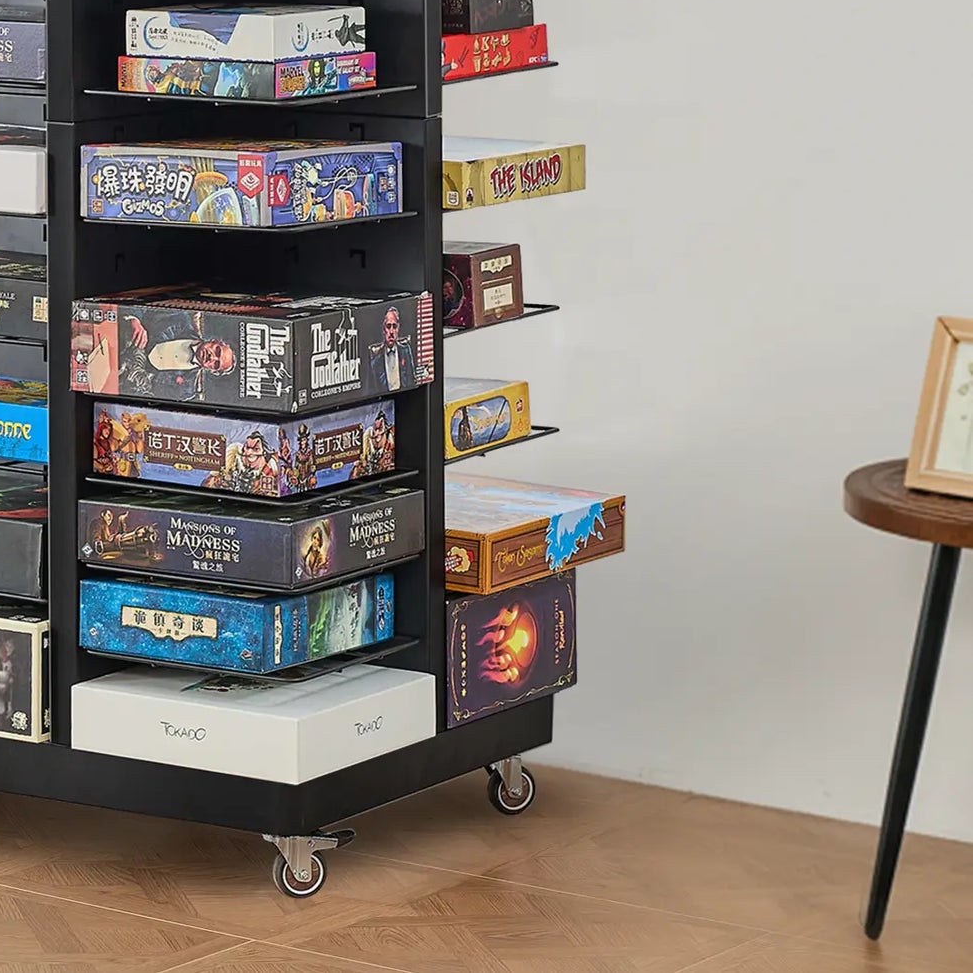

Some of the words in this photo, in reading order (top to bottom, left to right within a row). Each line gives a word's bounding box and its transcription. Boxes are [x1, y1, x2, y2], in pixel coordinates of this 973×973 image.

[280, 65, 304, 77] MARVEL
[96, 164, 194, 201] 爆珠發明
[489, 164, 517, 198] THE
[518, 153, 562, 193] ISLAND
[270, 326, 291, 356] The
[311, 323, 331, 354] The
[245, 322, 270, 399] Godfather
[310, 349, 361, 389] Godfather
[342, 381, 362, 392] EMPIRE
[148, 432, 222, 457] 诺丁汉警长
[314, 429, 361, 455] 诺丁汉警长
[149, 450, 174, 459] SHERIFF
[179, 454, 220, 465] NOTTINGHAM
[170, 516, 221, 534] MANSIONS
[223, 525, 237, 535] OF
[351, 509, 384, 525] MANSIONS
[384, 507, 393, 516] OF
[166, 530, 241, 554] MADNESS
[349, 519, 396, 543] MADNESS
